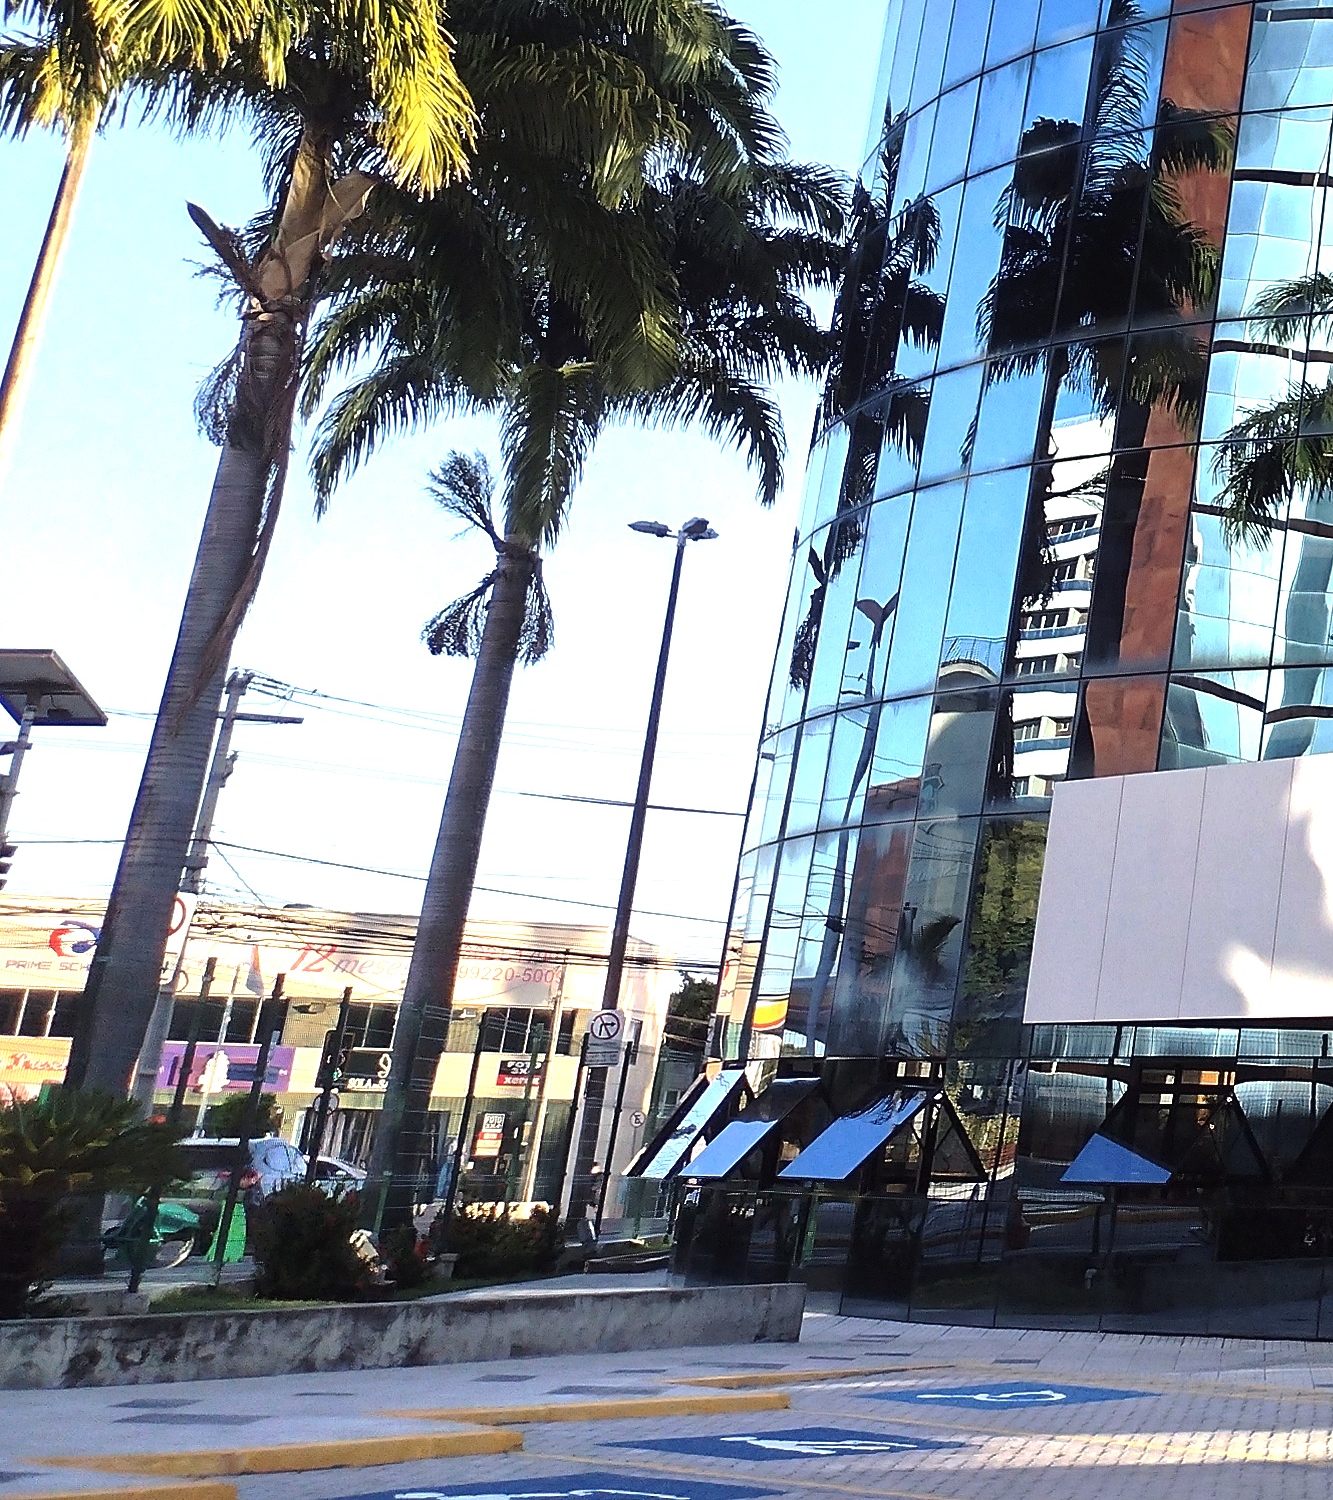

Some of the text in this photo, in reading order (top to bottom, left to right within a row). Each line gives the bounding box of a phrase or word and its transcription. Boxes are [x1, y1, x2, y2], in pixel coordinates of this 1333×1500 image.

[5, 960, 90, 971] PRIME SCH
[290, 942, 337, 972] 12
[333, 959, 408, 975] mese
